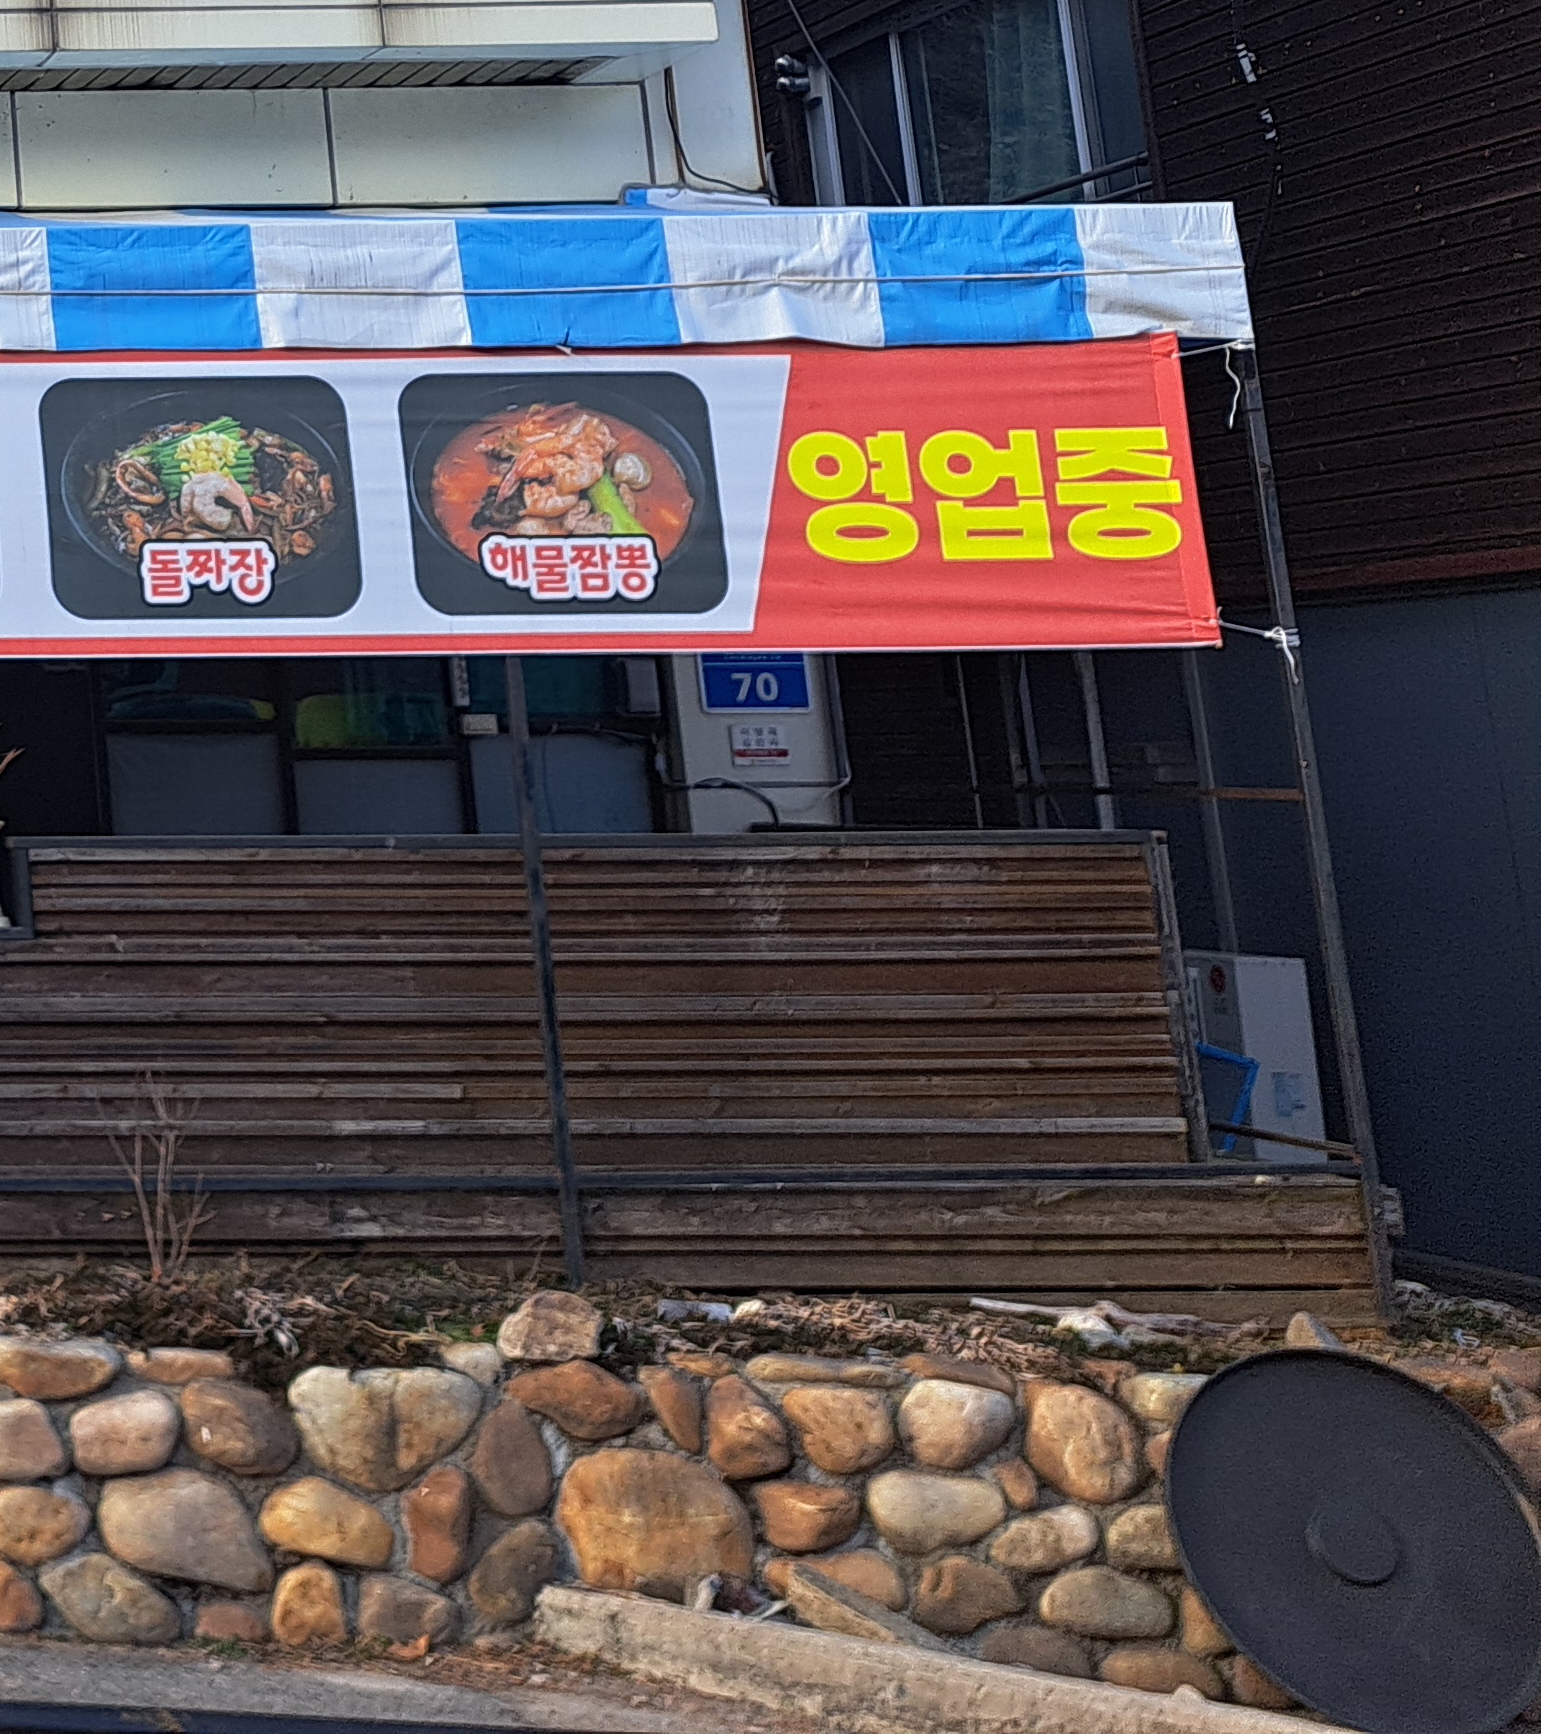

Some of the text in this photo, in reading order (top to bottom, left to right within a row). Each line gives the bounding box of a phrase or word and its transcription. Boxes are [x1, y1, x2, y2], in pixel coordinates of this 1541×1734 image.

[787, 426, 1183, 564] 영업중
[147, 547, 270, 598] 돌짜장
[487, 541, 654, 595] 해물짬뽕
[730, 671, 779, 703] 70
